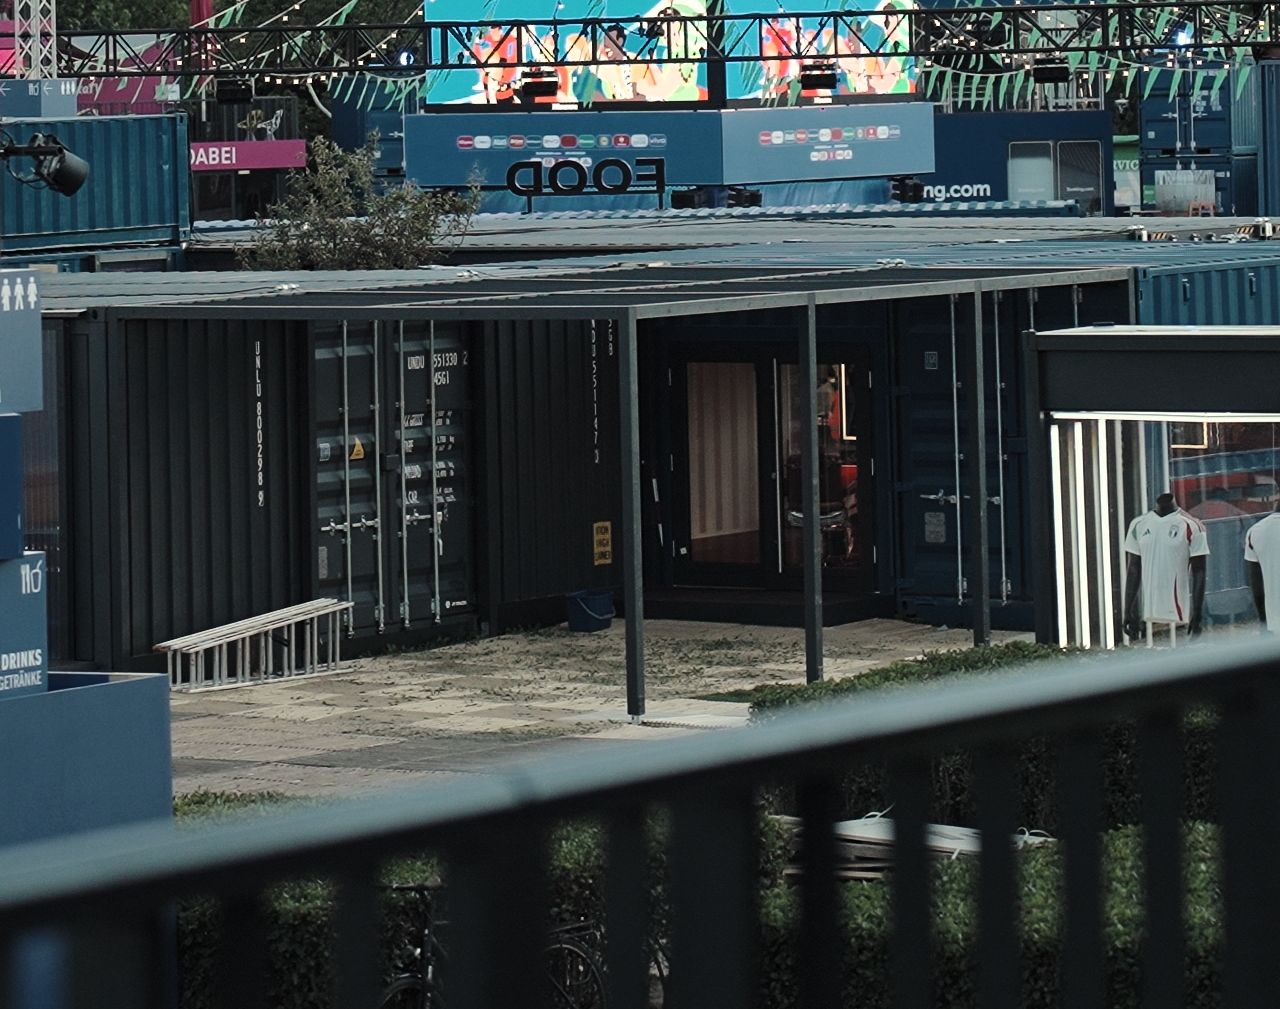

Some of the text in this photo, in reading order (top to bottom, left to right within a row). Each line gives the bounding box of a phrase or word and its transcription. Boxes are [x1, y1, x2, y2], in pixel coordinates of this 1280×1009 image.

[922, 183, 991, 201] ng.com
[254, 340, 263, 398] UNLU
[255, 400, 265, 487] 800298
